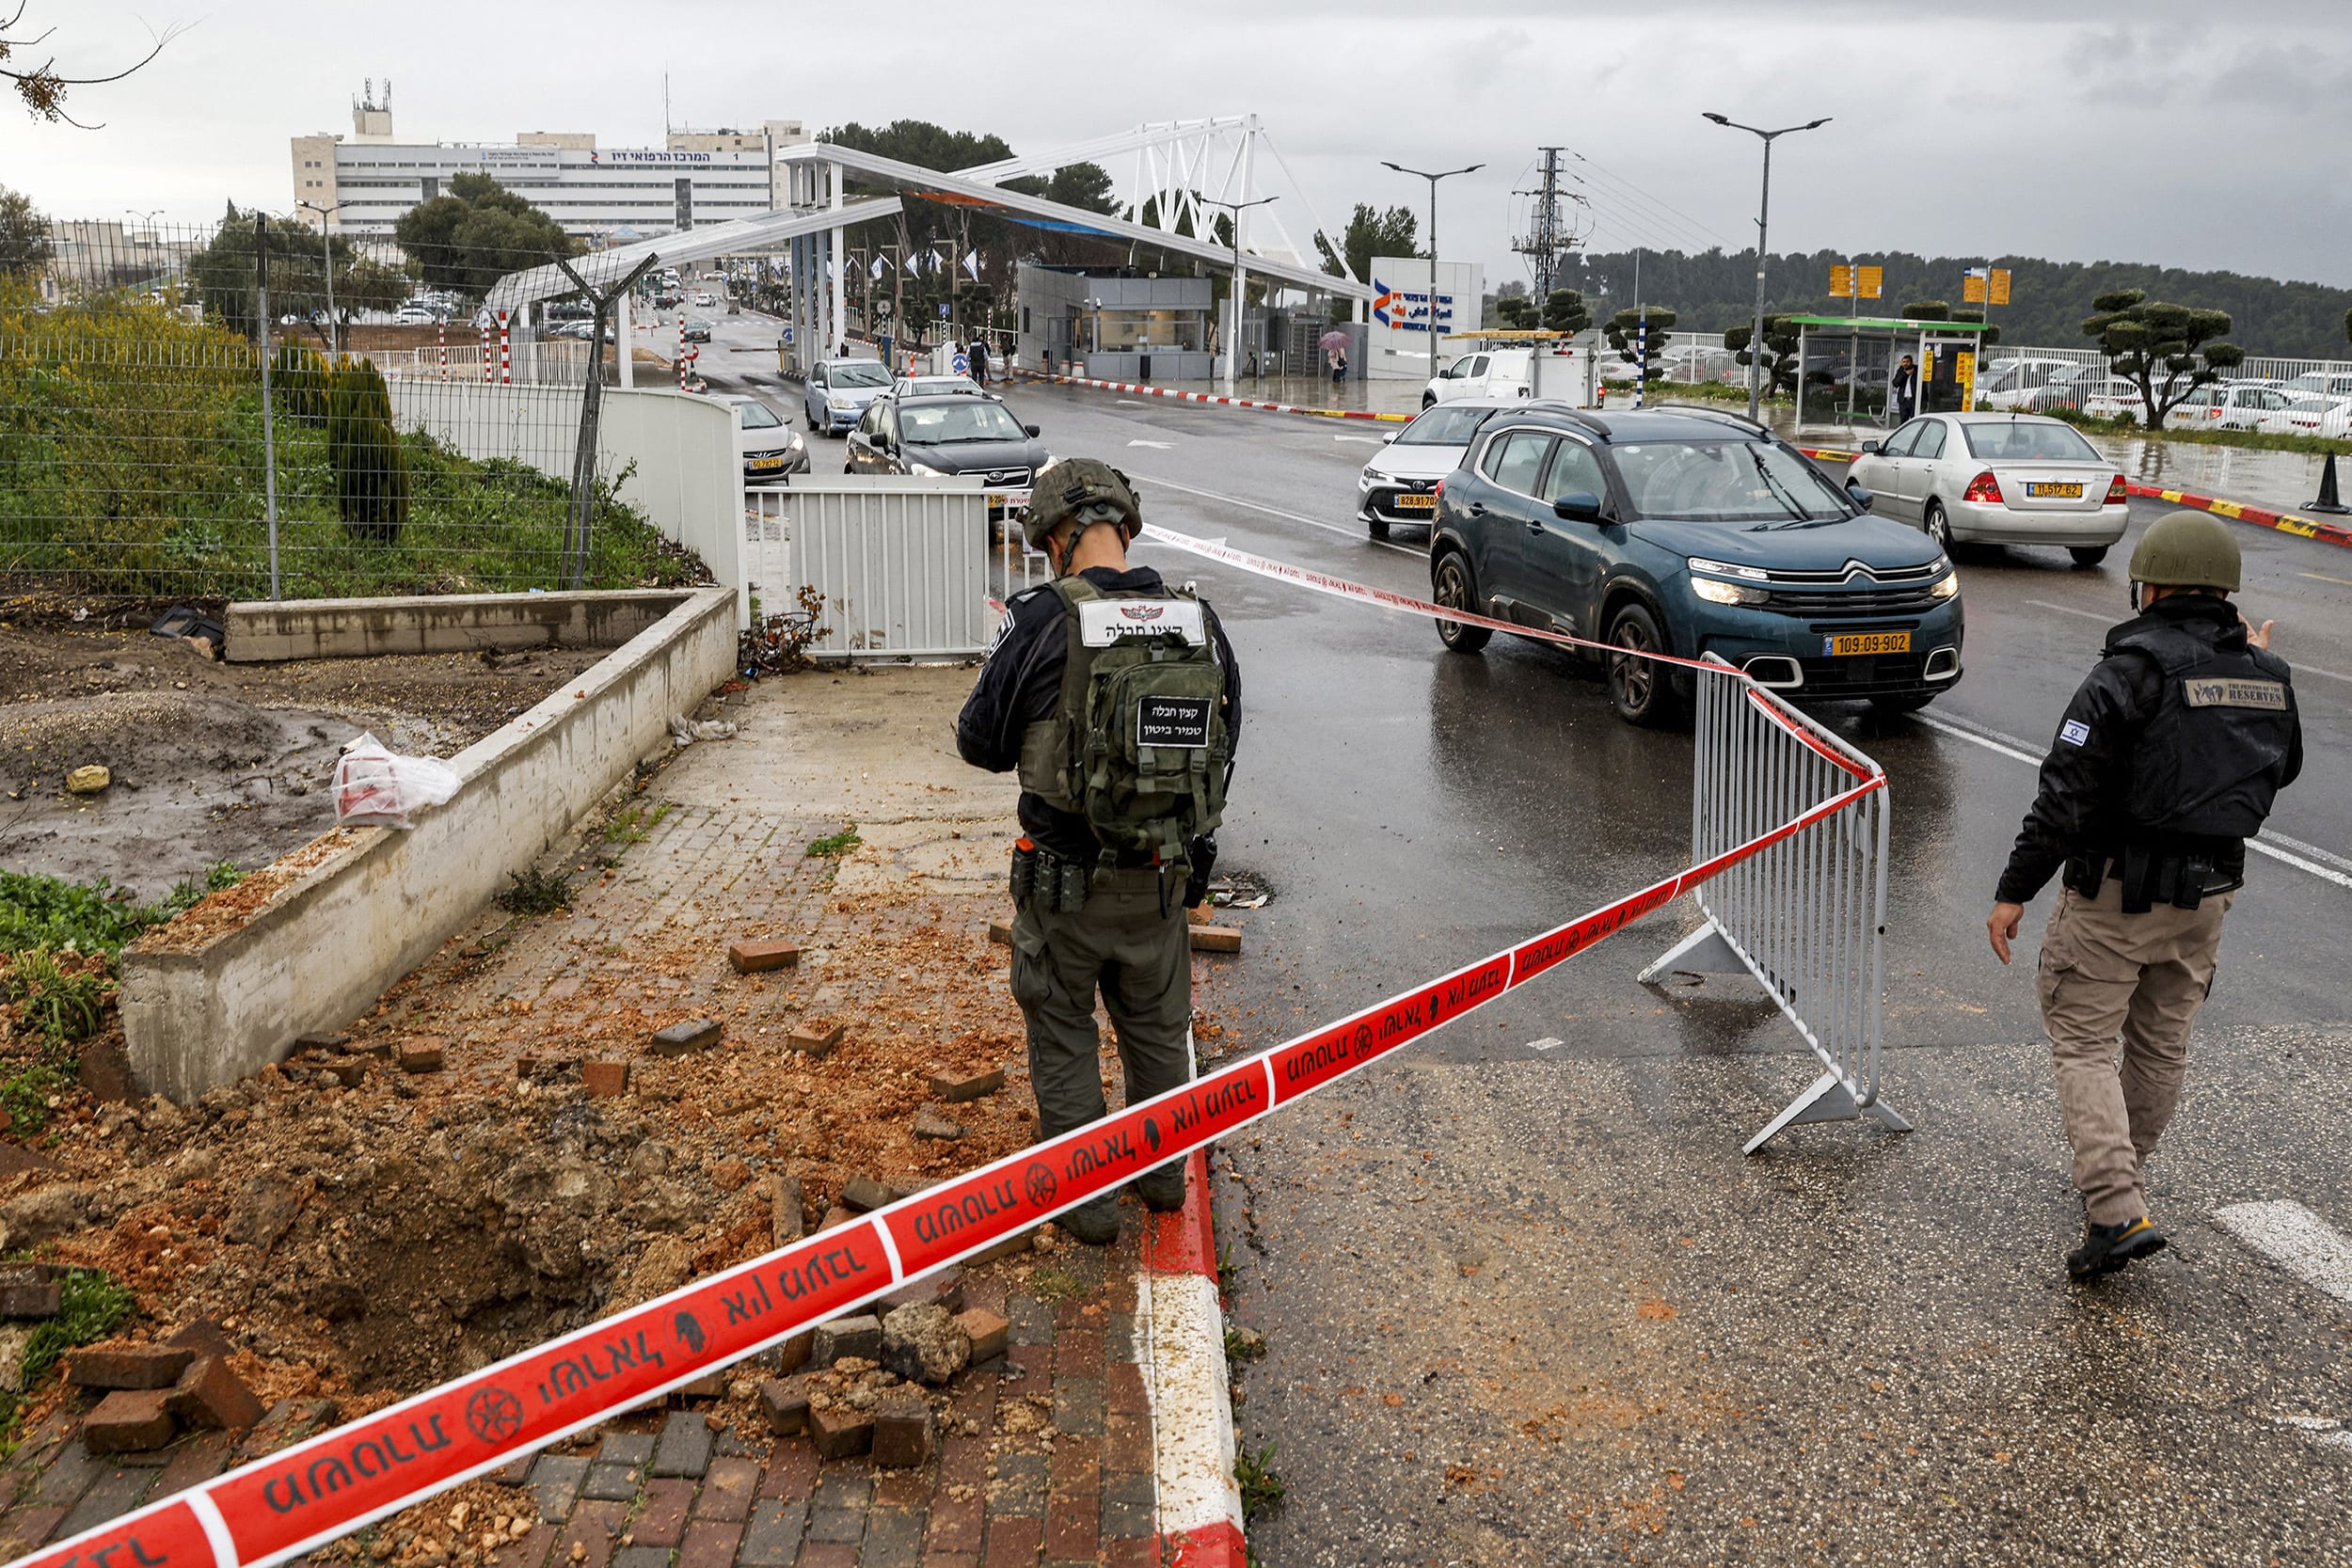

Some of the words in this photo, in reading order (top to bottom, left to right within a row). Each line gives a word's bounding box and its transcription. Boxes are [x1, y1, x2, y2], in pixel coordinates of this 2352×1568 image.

[612, 152, 627, 162] זיו
[631, 152, 671, 162] הרפואי
[674, 153, 710, 162] המרכז
[2228, 689, 2281, 703] RESERVES
[1152, 704, 1176, 717] חבלה
[1179, 707, 1198, 720] קצין
[1144, 724, 1172, 736] ביטון
[1175, 726, 1202, 736] טמיר
[1287, 1035, 1348, 1081] משטרת
[1379, 1003, 1421, 1040] ישראל
[1446, 979, 1465, 1008] אין
[1468, 970, 1500, 998] מעבר
[915, 1179, 1018, 1243] משטרת
[1065, 1131, 1136, 1182] ישראל
[1174, 1095, 1200, 1134] אין
[1205, 1078, 1256, 1118] מעבר
[263, 1414, 453, 1513] משטרת
[538, 1330, 665, 1403] ישראל
[720, 1278, 772, 1326] אין
[779, 1247, 866, 1300] מעבר
